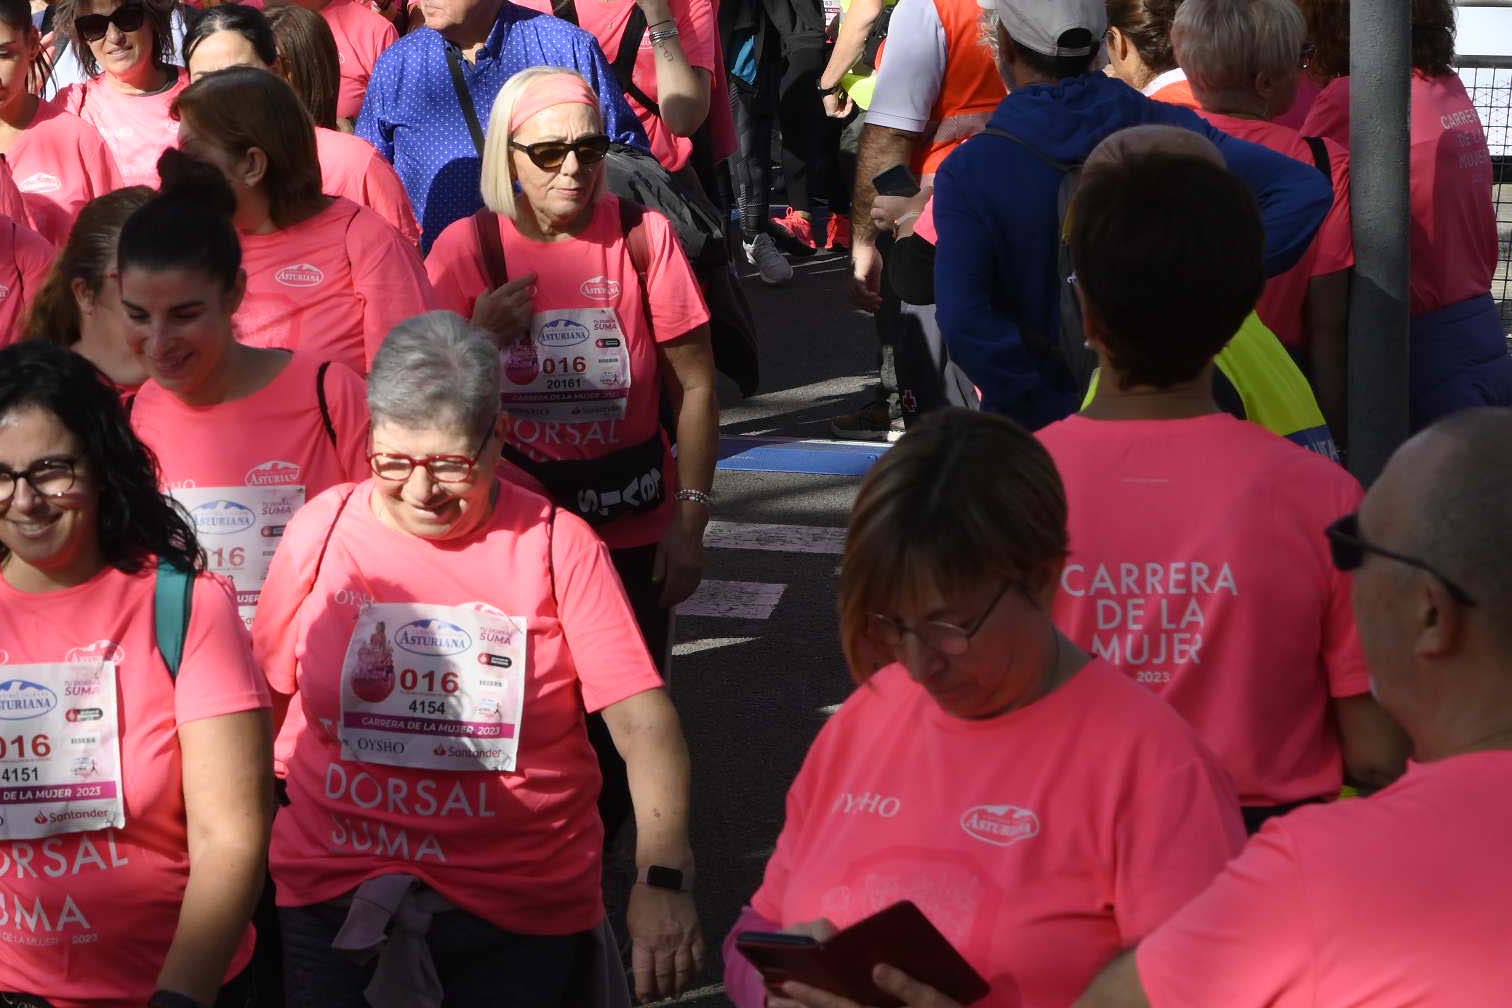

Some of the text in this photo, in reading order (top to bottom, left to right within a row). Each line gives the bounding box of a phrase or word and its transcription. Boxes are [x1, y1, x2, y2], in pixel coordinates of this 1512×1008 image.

[594, 322, 617, 331] SUMA
[541, 331, 586, 342] ASTURIANA
[542, 356, 586, 374] 016
[547, 379, 582, 390] 20161
[262, 506, 292, 515] SUMA
[1061, 562, 1239, 596] CARRERA
[1097, 599, 1205, 631] DE LA
[400, 631, 465, 649] ASTURIANA
[480, 632, 512, 645] SUMA
[1092, 633, 1202, 665] MUJER
[400, 668, 459, 696] 016
[1136, 671, 1170, 683] 2023
[409, 699, 446, 714] 4154
[361, 716, 501, 735] CARRERA DE LA MUJER 2023
[357, 737, 502, 759] OYSHO Santander
[2, 767, 38, 782] 4151
[3, 791, 18, 800] DE
[19, 790, 33, 799] LA
[36, 788, 72, 798] MUJER
[76, 787, 102, 797] 2023
[325, 762, 495, 818] DORSAL
[49, 810, 109, 823] Santander
[331, 813, 446, 862] SUMA
